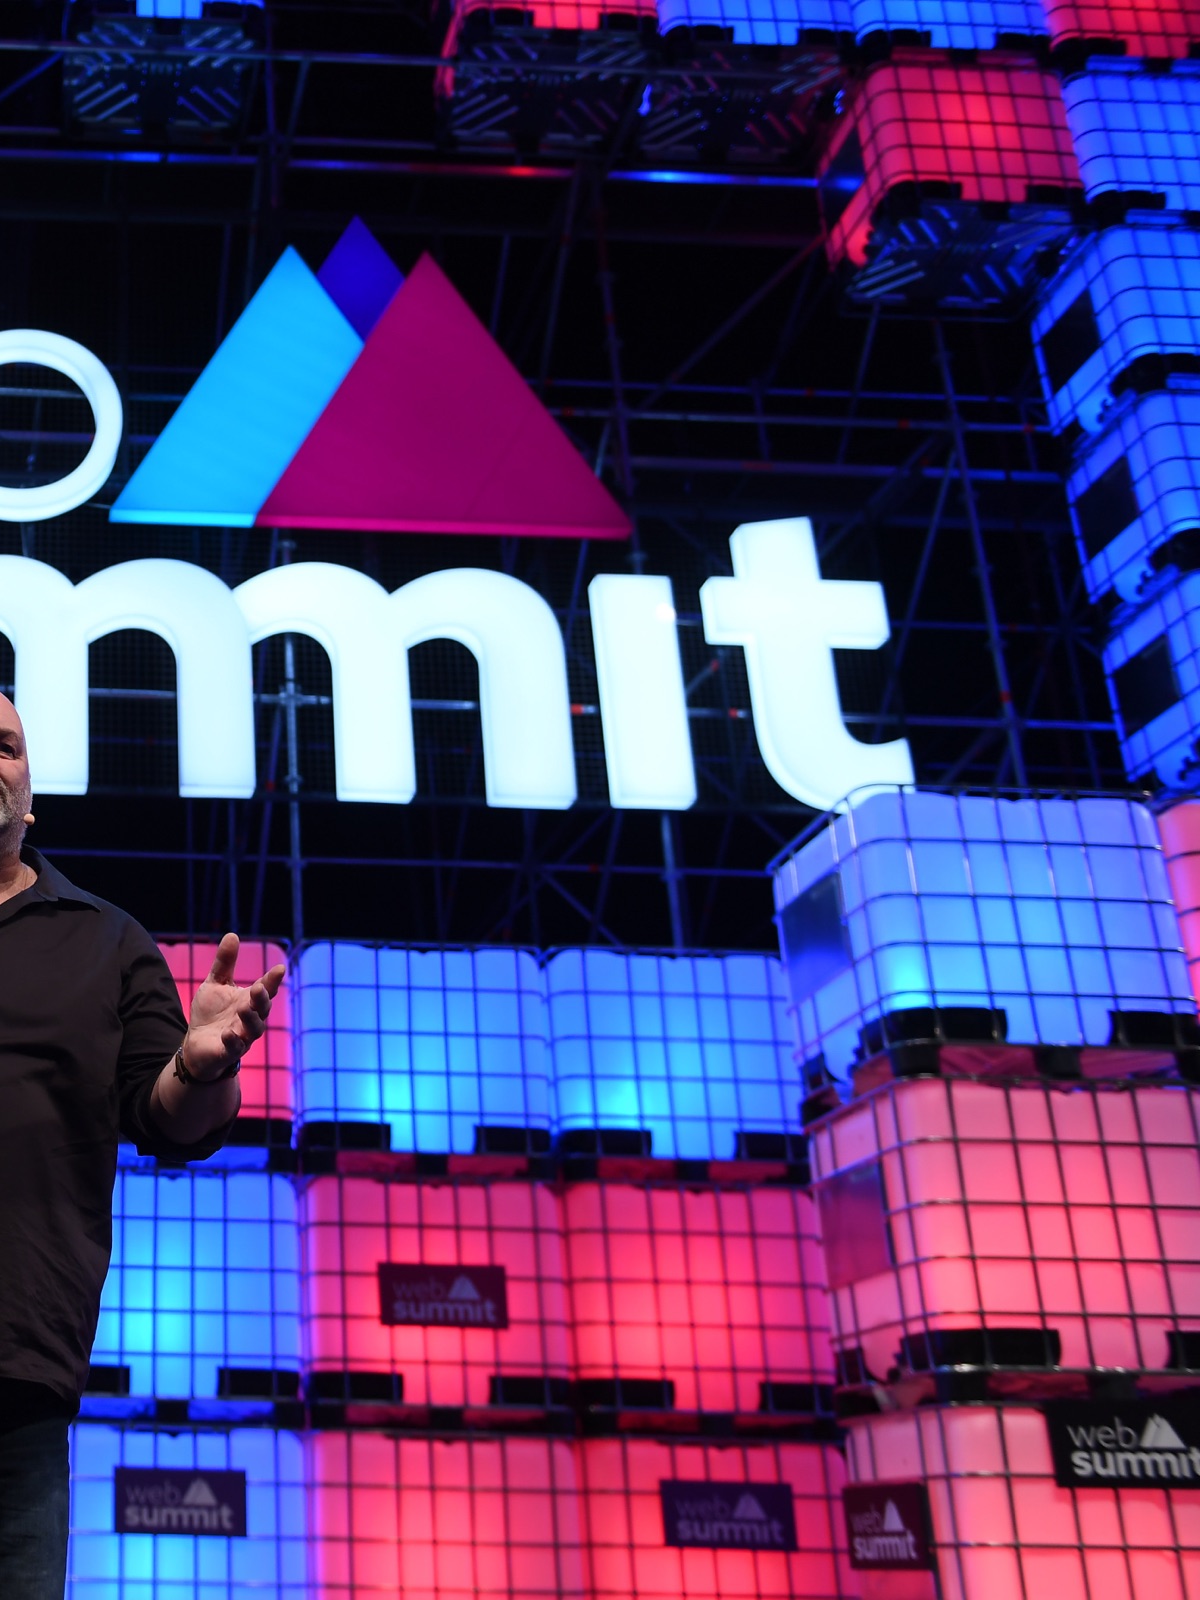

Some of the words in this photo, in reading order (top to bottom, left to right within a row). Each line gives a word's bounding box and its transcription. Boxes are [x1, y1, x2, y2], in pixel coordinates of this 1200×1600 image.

[392, 1276, 446, 1300] web
[393, 1298, 497, 1323] summit
[1066, 1415, 1138, 1449] web
[1070, 1446, 1200, 1479] summit
[125, 1480, 180, 1505] web
[125, 1503, 234, 1530] summit
[675, 1494, 730, 1519] web
[677, 1519, 784, 1545] summit
[852, 1529, 918, 1560] summit
